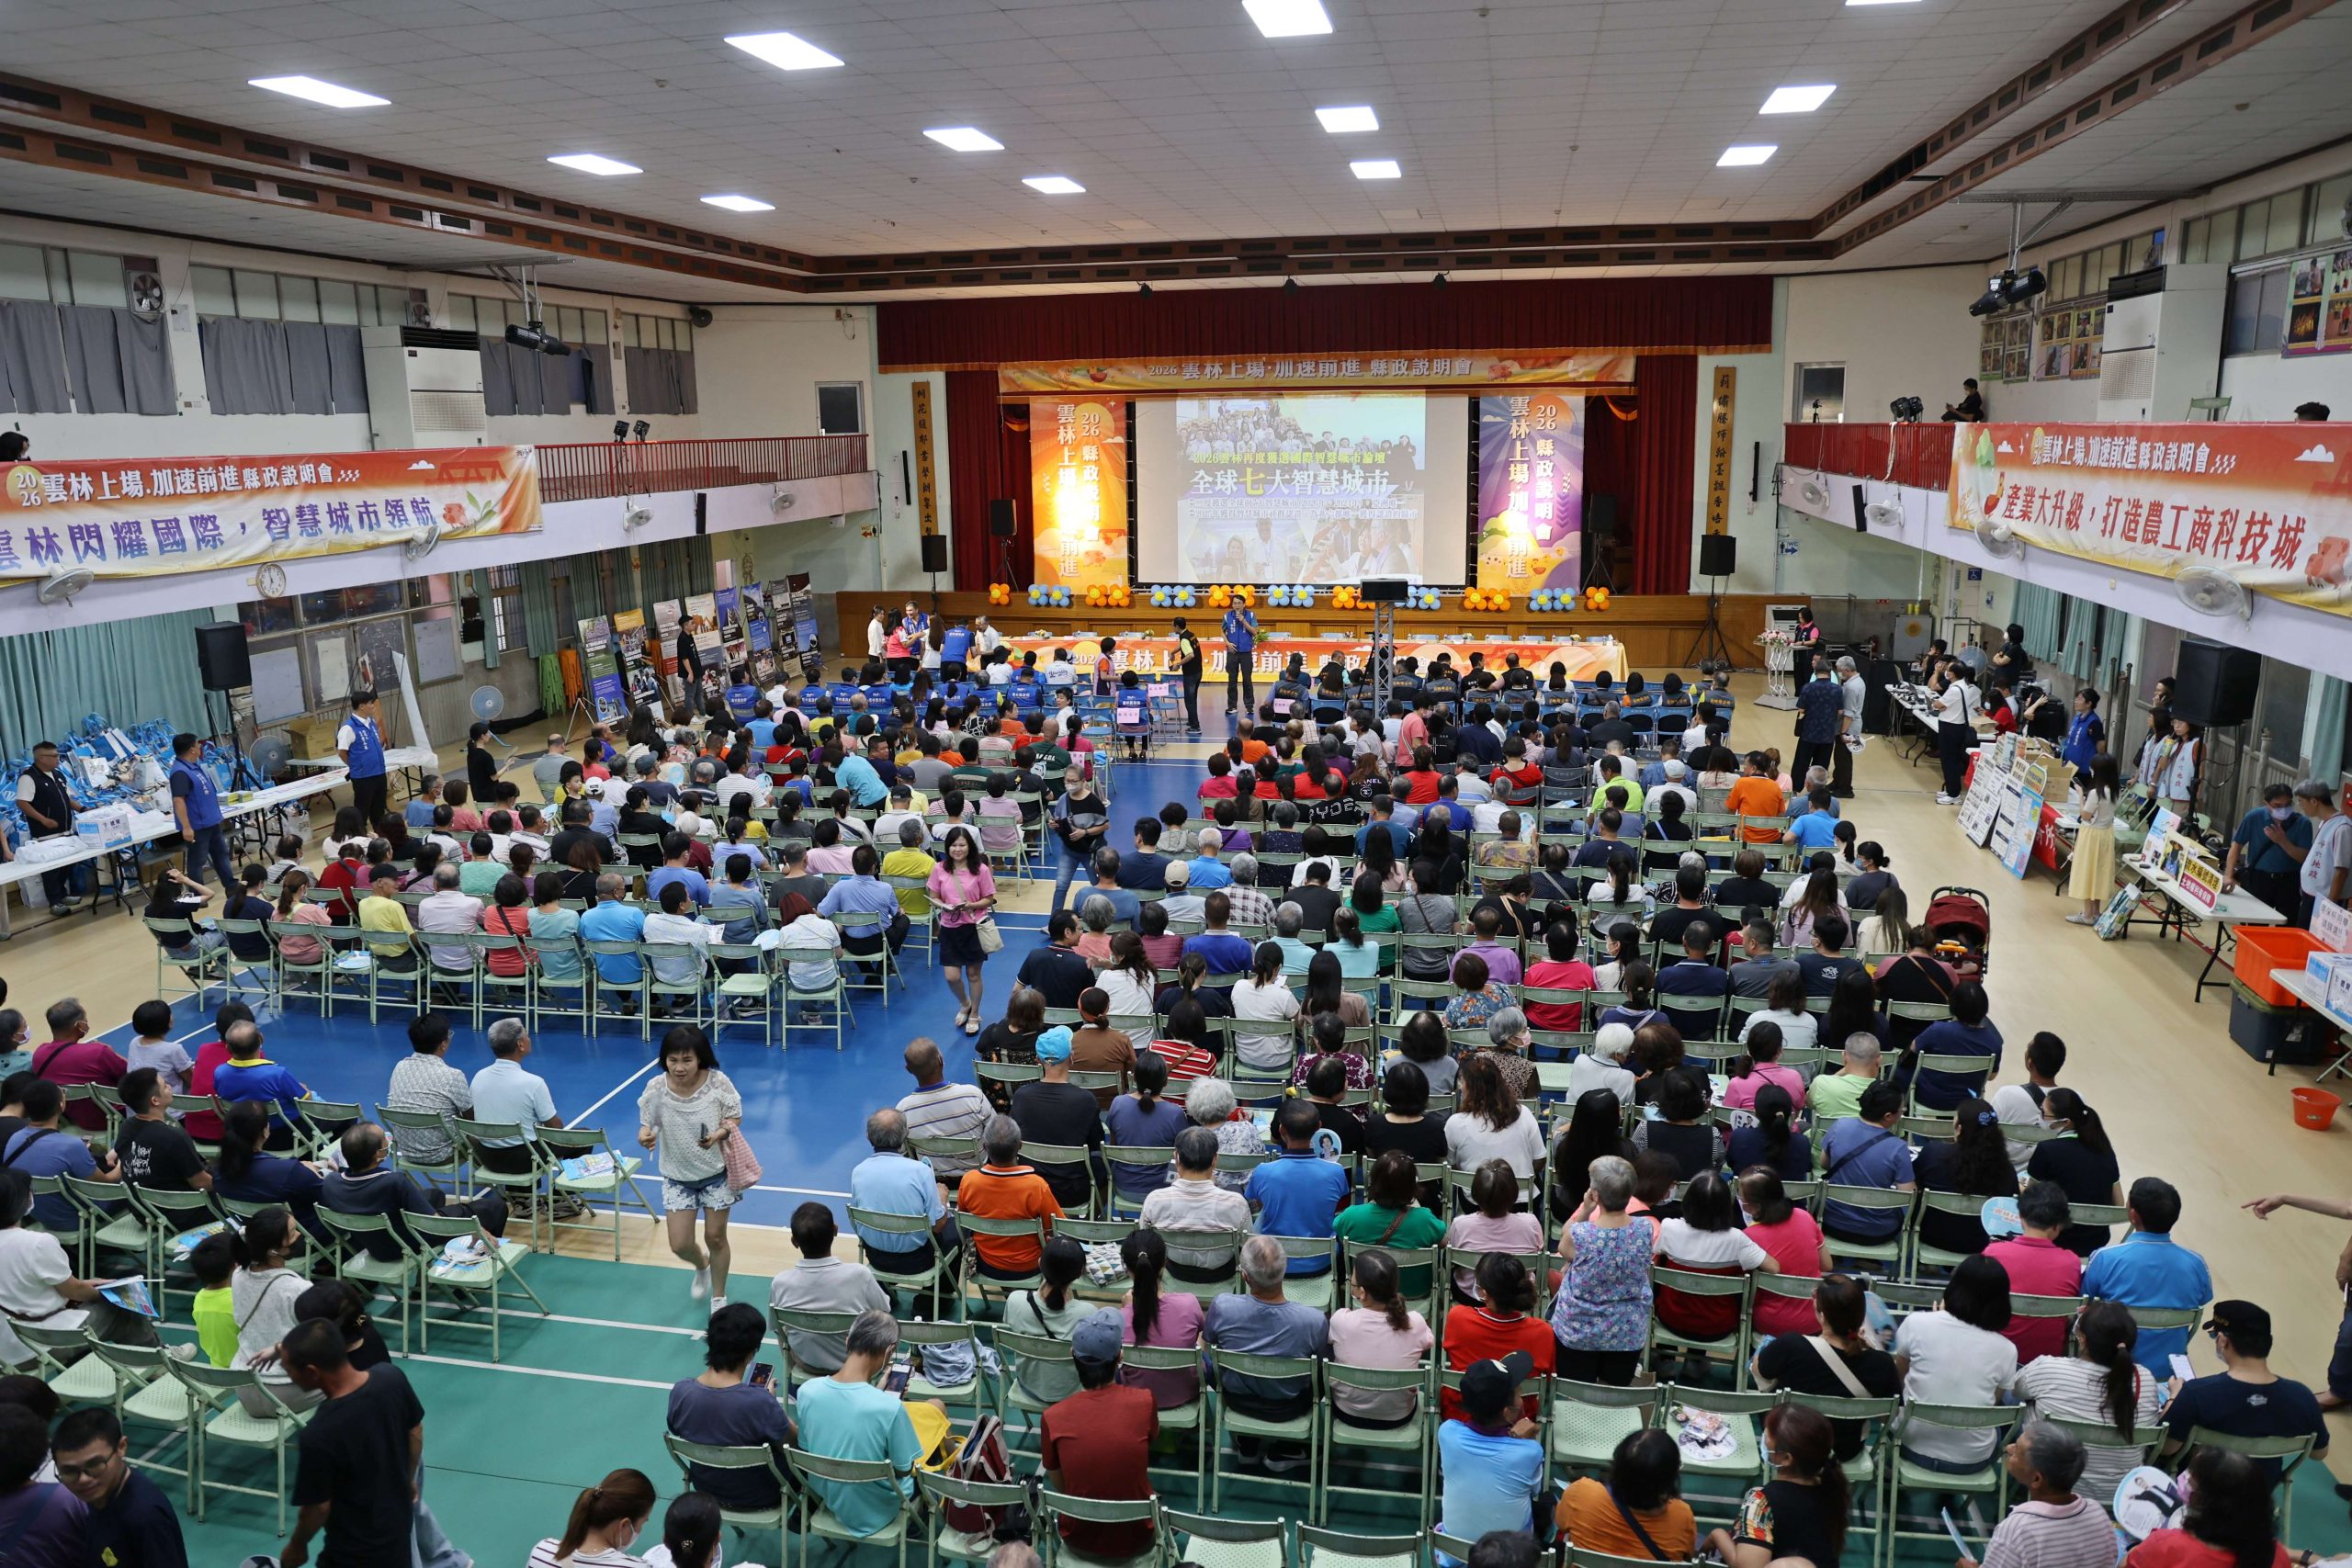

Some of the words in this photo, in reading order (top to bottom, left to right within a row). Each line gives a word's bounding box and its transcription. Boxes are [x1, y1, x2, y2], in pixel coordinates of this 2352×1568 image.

[1148, 366, 1178, 377] 2026
[1190, 467, 1390, 496] 全球七大智慧城市
[1074, 654, 1096, 665] 202
[2308, 840, 2326, 880] 斗六地政
